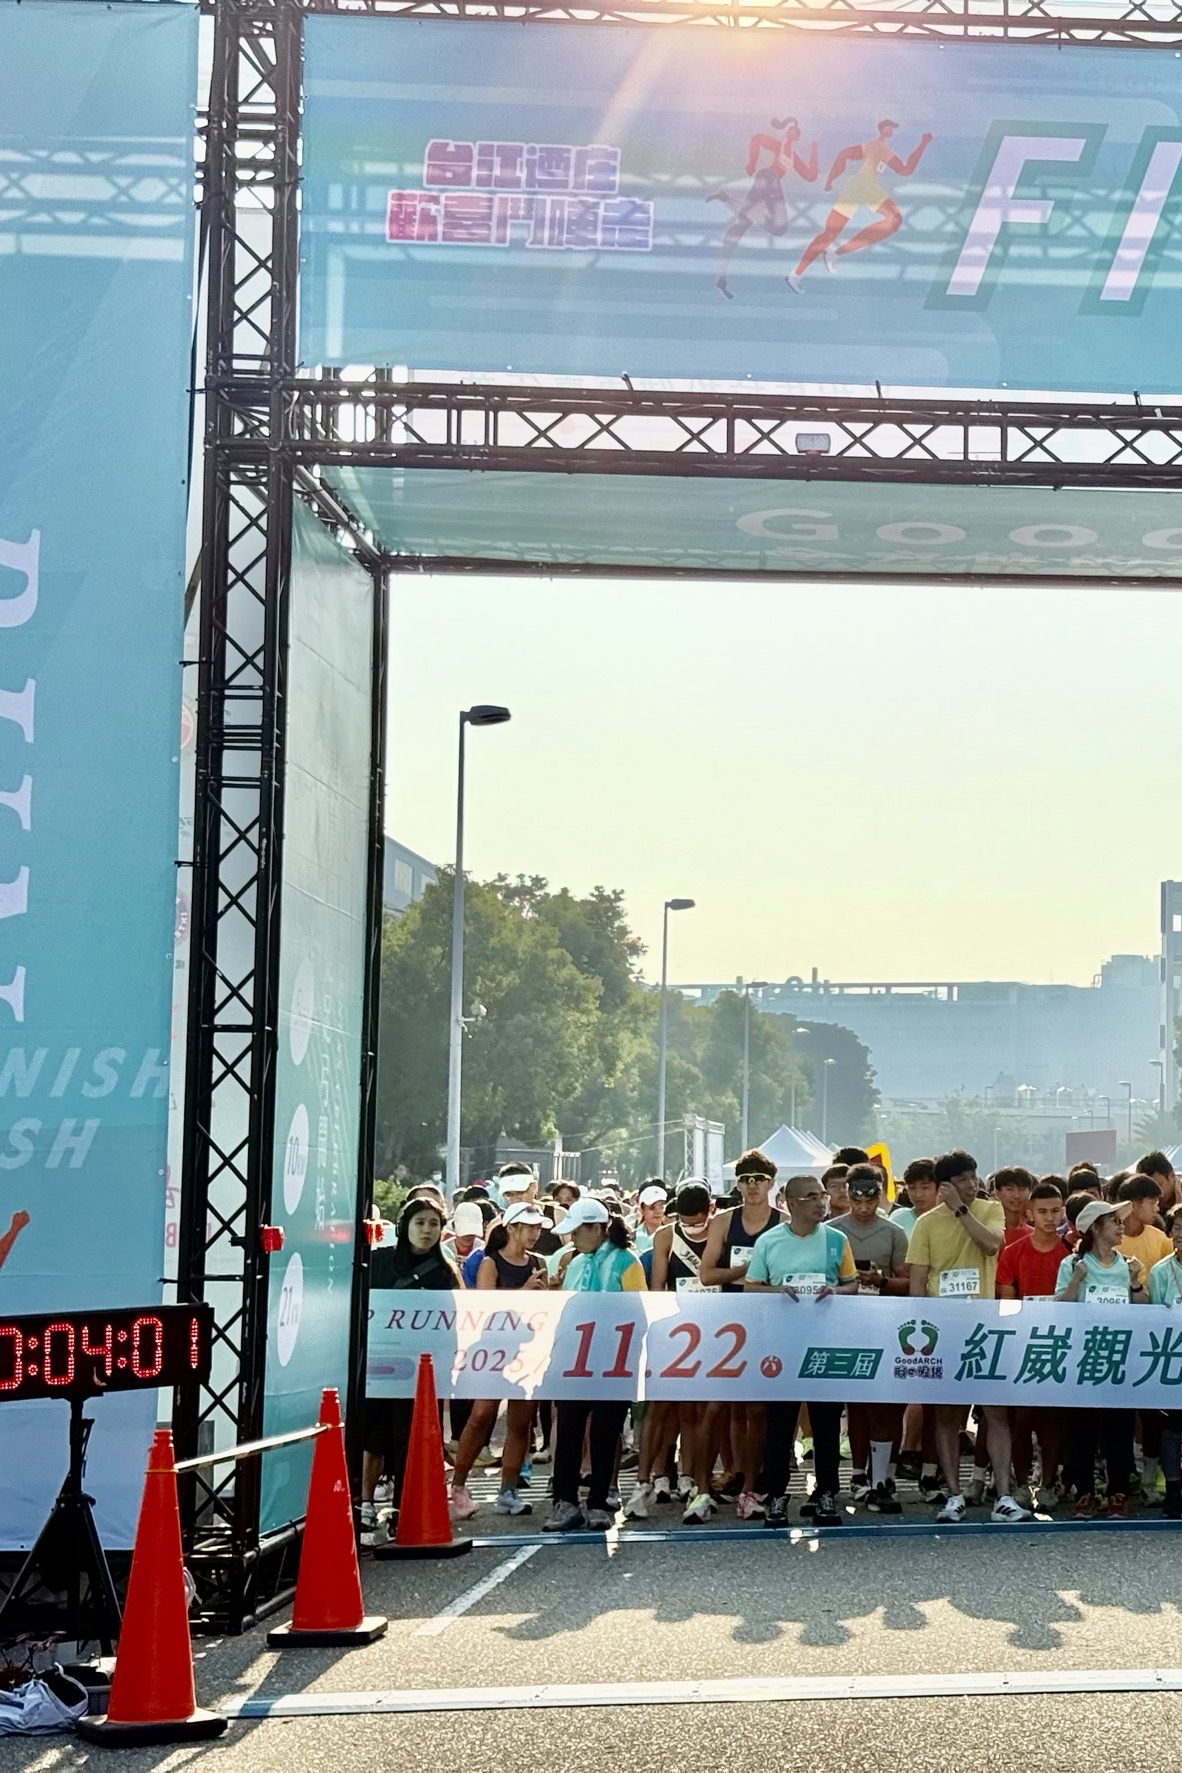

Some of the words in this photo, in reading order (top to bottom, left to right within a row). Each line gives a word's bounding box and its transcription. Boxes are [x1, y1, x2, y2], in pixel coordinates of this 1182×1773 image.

[949, 1282, 978, 1293] 31167
[384, 1308, 550, 1332] RUNNING
[563, 1320, 747, 1379] 11.22
[895, 1355, 943, 1365] GoodARCH
[804, 1350, 876, 1378] 第三屆
